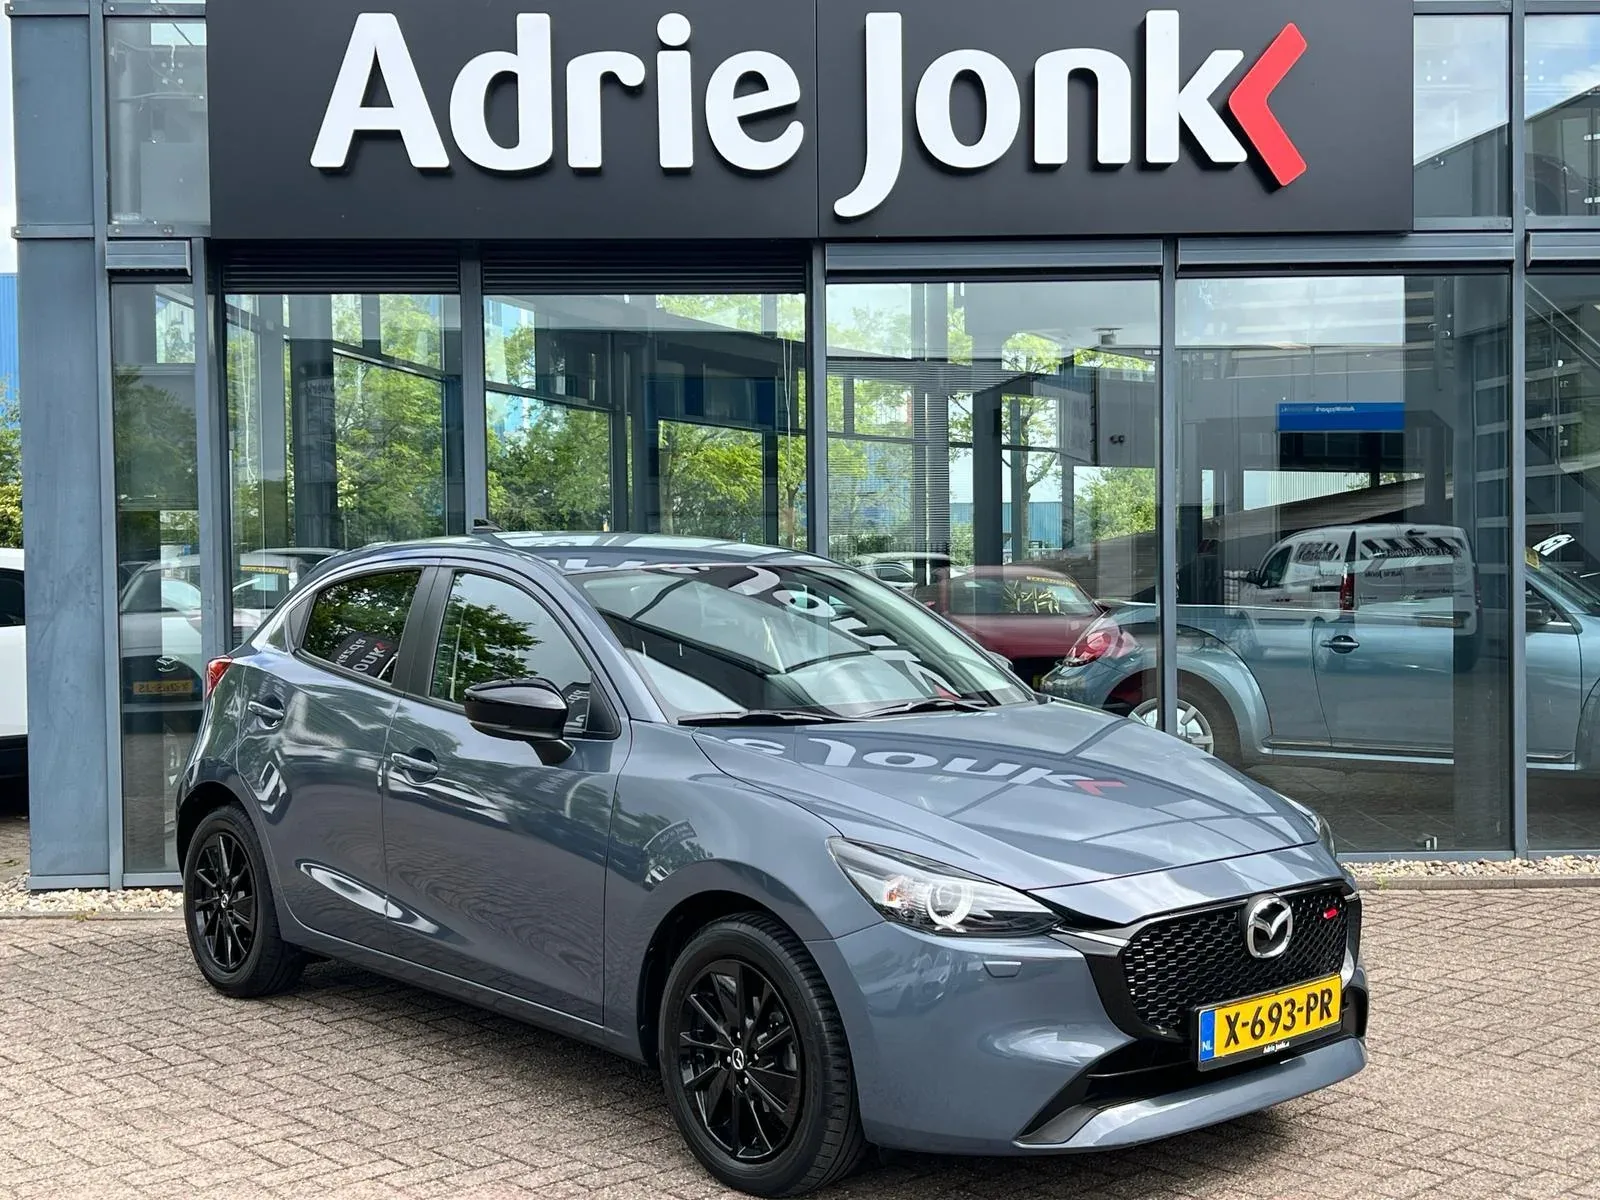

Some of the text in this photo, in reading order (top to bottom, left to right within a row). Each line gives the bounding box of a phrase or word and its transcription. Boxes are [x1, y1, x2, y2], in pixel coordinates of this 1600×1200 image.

[310, 9, 1249, 218] Adrie Jonk
[1201, 1040, 1213, 1052] NL
[1224, 988, 1333, 1048] X-693-PR
